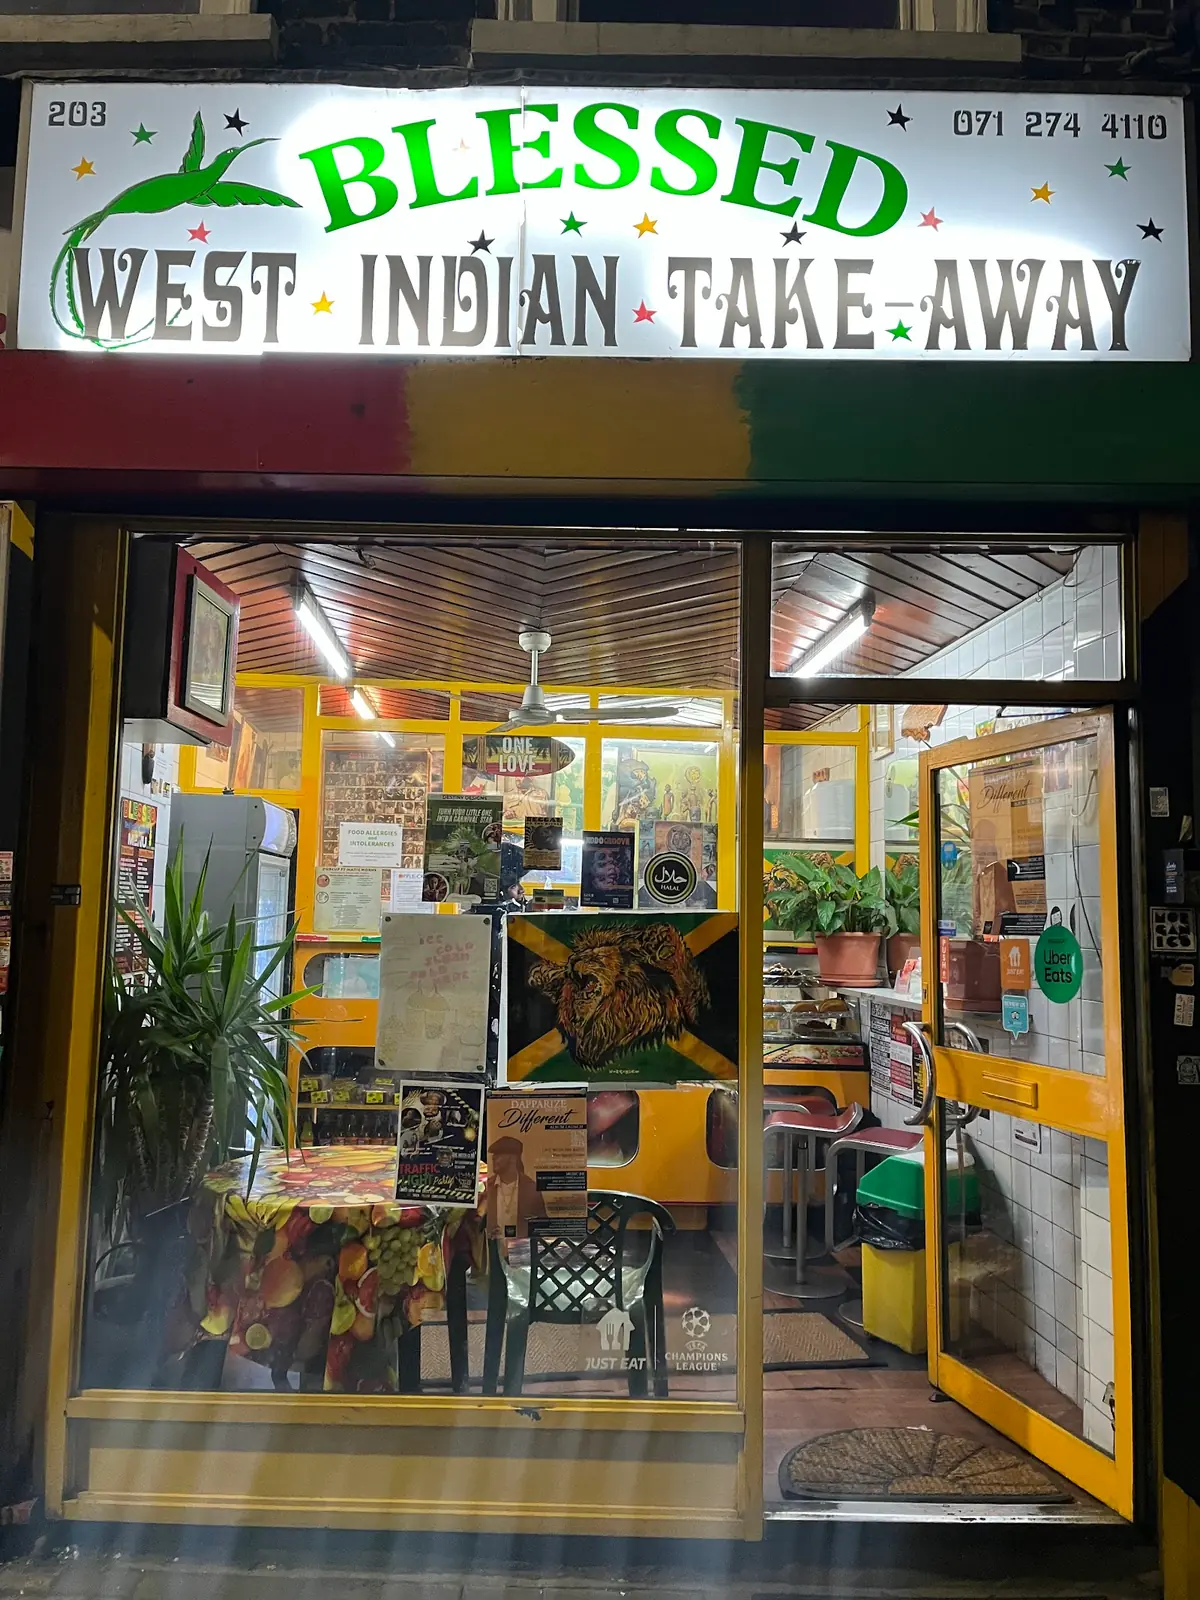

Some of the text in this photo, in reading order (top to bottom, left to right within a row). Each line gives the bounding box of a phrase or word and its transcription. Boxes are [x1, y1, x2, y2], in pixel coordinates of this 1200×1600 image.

[48, 101, 107, 127] 203
[953, 109, 1168, 141] 071 274 4110
[298, 102, 909, 238] BLESSED
[75, 247, 1143, 353] WEST INDIAN TAKE-AWAY
[502, 736, 535, 754] ONE
[499, 754, 536, 773] LOVE
[365, 829, 398, 837] ALLERGIES
[349, 840, 395, 848] INTOLERANCES
[1043, 949, 1072, 965] Uber
[1044, 967, 1073, 983] Eats
[511, 1099, 567, 1109] DAPPARIZE
[497, 1108, 578, 1133] Different
[399, 1163, 440, 1175] TRAFFIC
[399, 1173, 433, 1186] LIGHT
[686, 1340, 708, 1351] UEFA
[585, 1357, 647, 1371] JUST EAT
[664, 1351, 729, 1363] CHAMPIONS
[675, 1361, 718, 1372] LEAGUE
